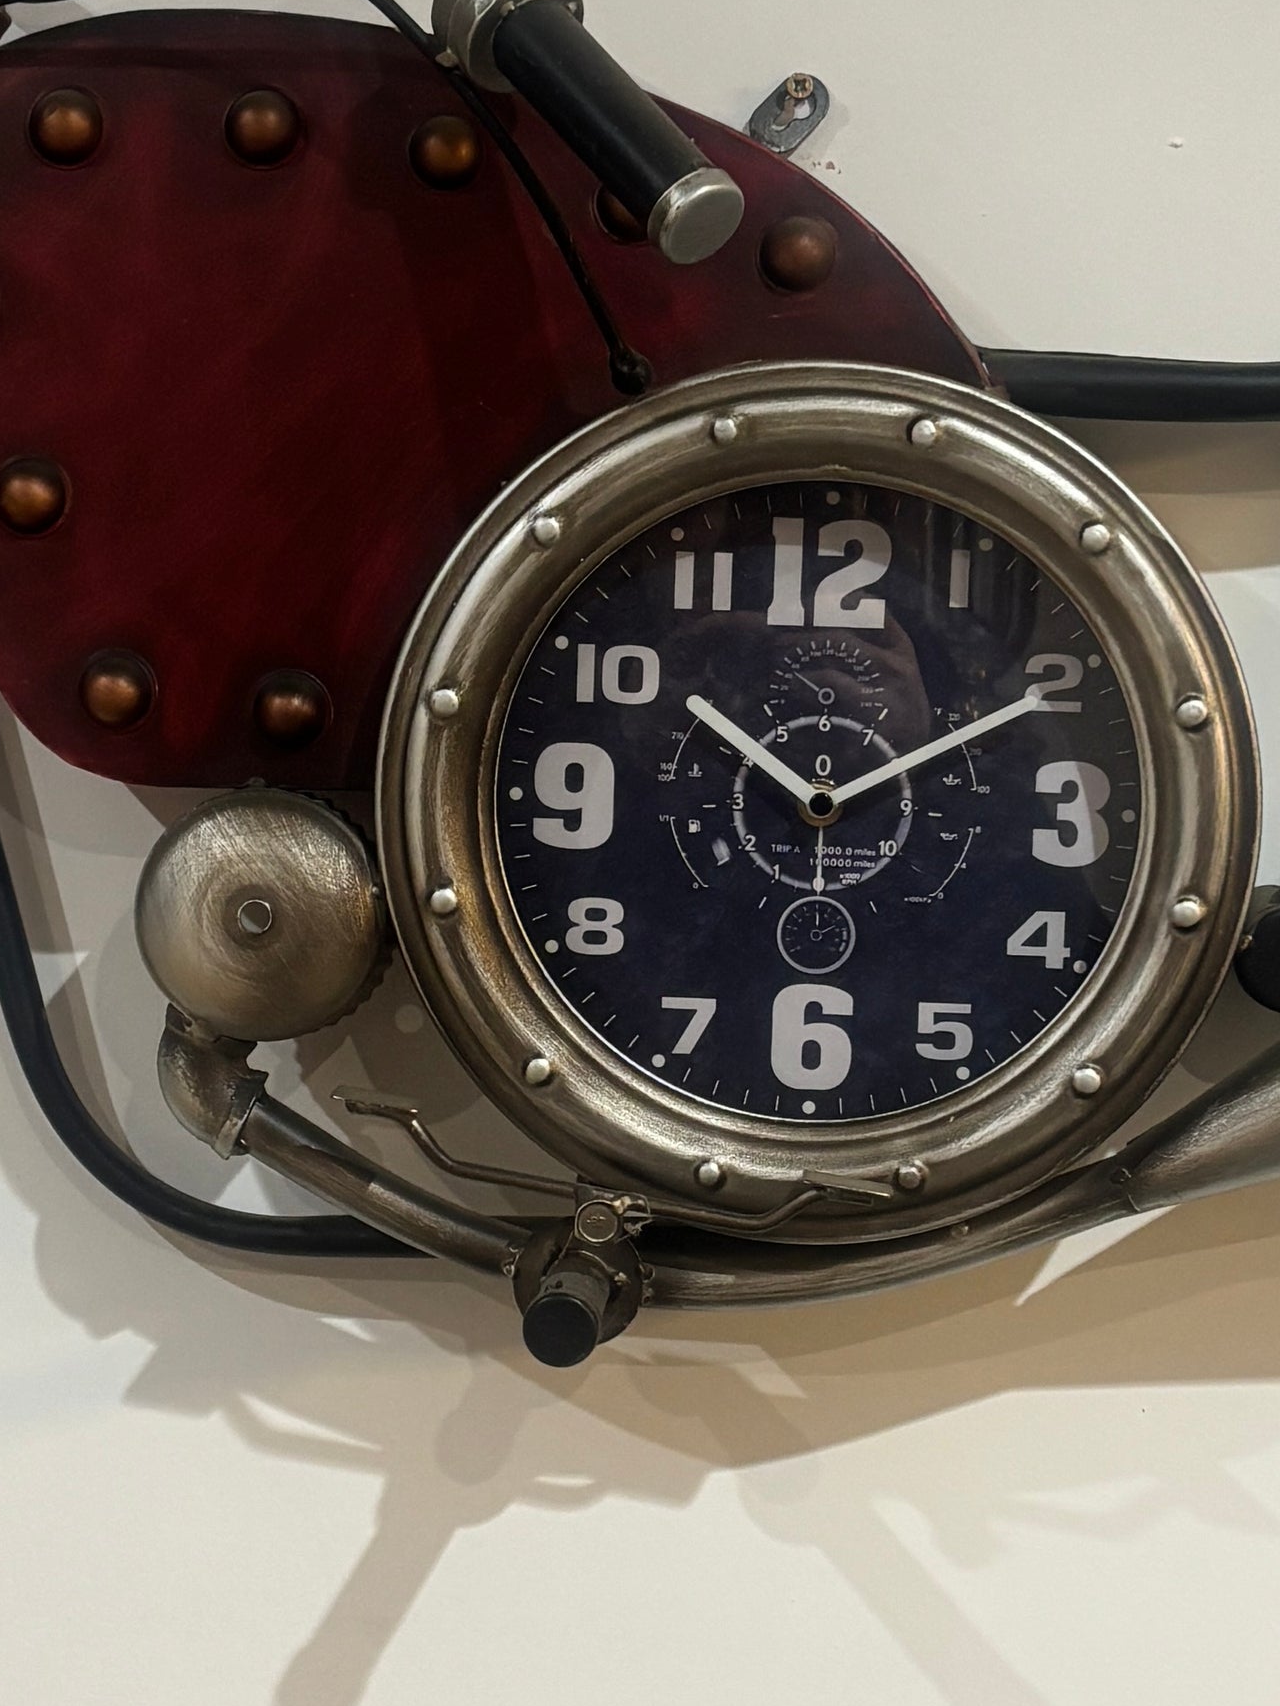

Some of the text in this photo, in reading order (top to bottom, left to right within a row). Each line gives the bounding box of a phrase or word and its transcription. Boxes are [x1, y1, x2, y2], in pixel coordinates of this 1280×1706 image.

[674, 550, 733, 611] 11
[767, 517, 893, 629] 12
[574, 643, 660, 704] 10
[1024, 653, 1083, 713] 2
[776, 726, 788, 742] 5
[819, 715, 831, 732] 6
[862, 729, 874, 746] 7
[815, 754, 832, 776] 0
[533, 742, 615, 849] 9
[732, 793, 744, 810] 3
[900, 800, 912, 816] 9
[1032, 760, 1111, 868] 3
[744, 835, 756, 851] 2
[771, 844, 792, 853] TRIP
[878, 840, 898, 857] 10
[773, 864, 780, 880] 1
[564, 897, 625, 955] 8
[1006, 910, 1071, 970] 4
[659, 997, 717, 1054] 7
[770, 983, 853, 1091] 6
[915, 1002, 974, 1061] 5
